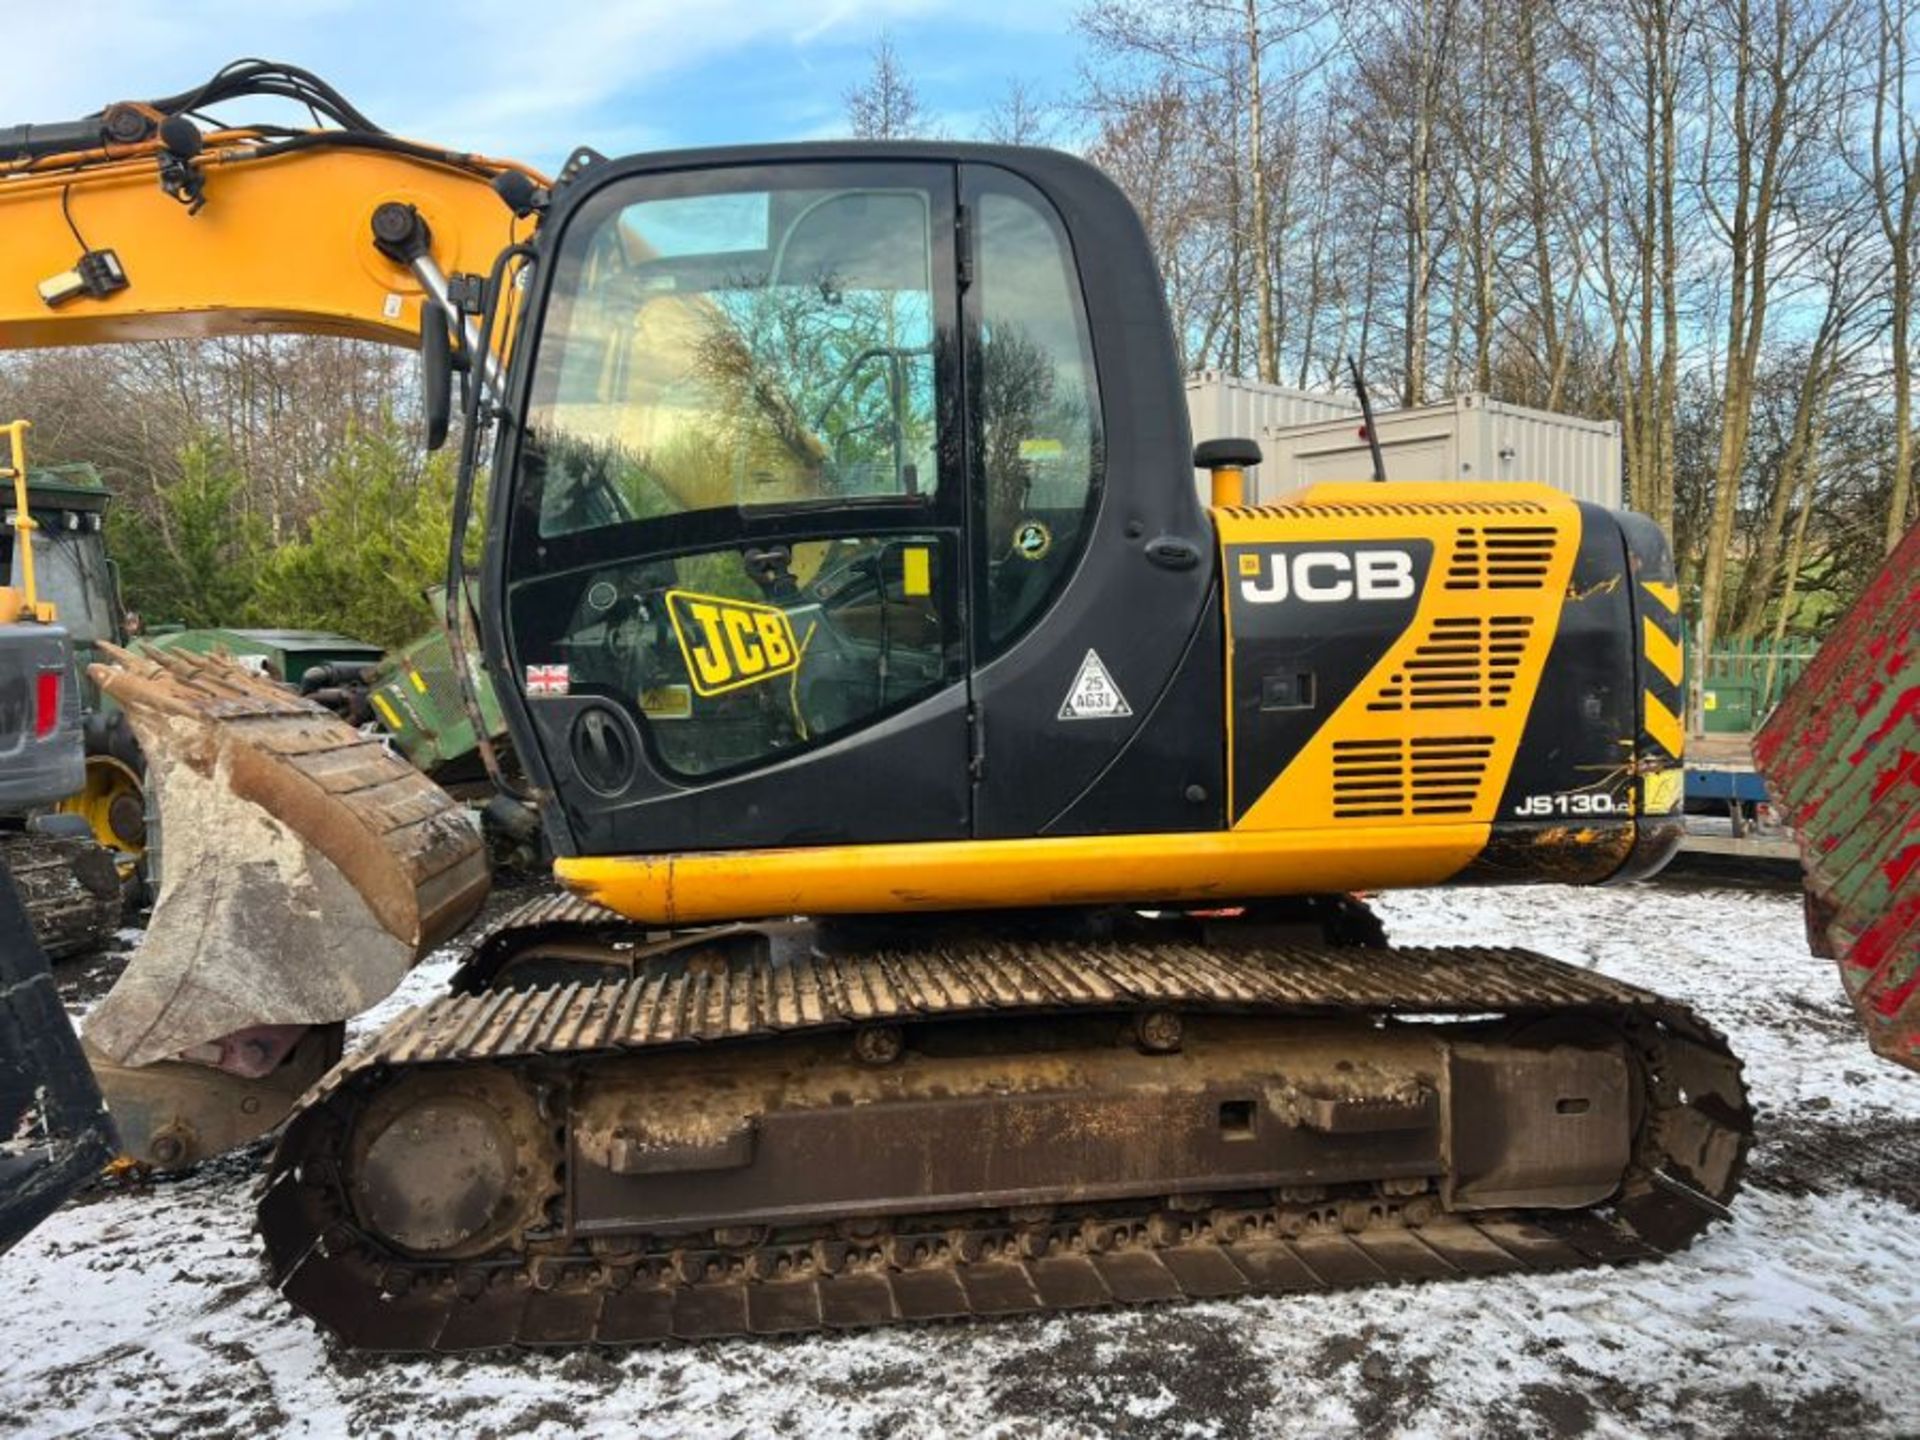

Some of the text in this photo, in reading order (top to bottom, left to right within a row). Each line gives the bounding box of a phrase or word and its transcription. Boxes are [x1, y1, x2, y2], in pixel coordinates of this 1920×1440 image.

[1240, 551, 1415, 603] JCB
[690, 603, 791, 684] JCB
[1085, 676, 1104, 691] 25
